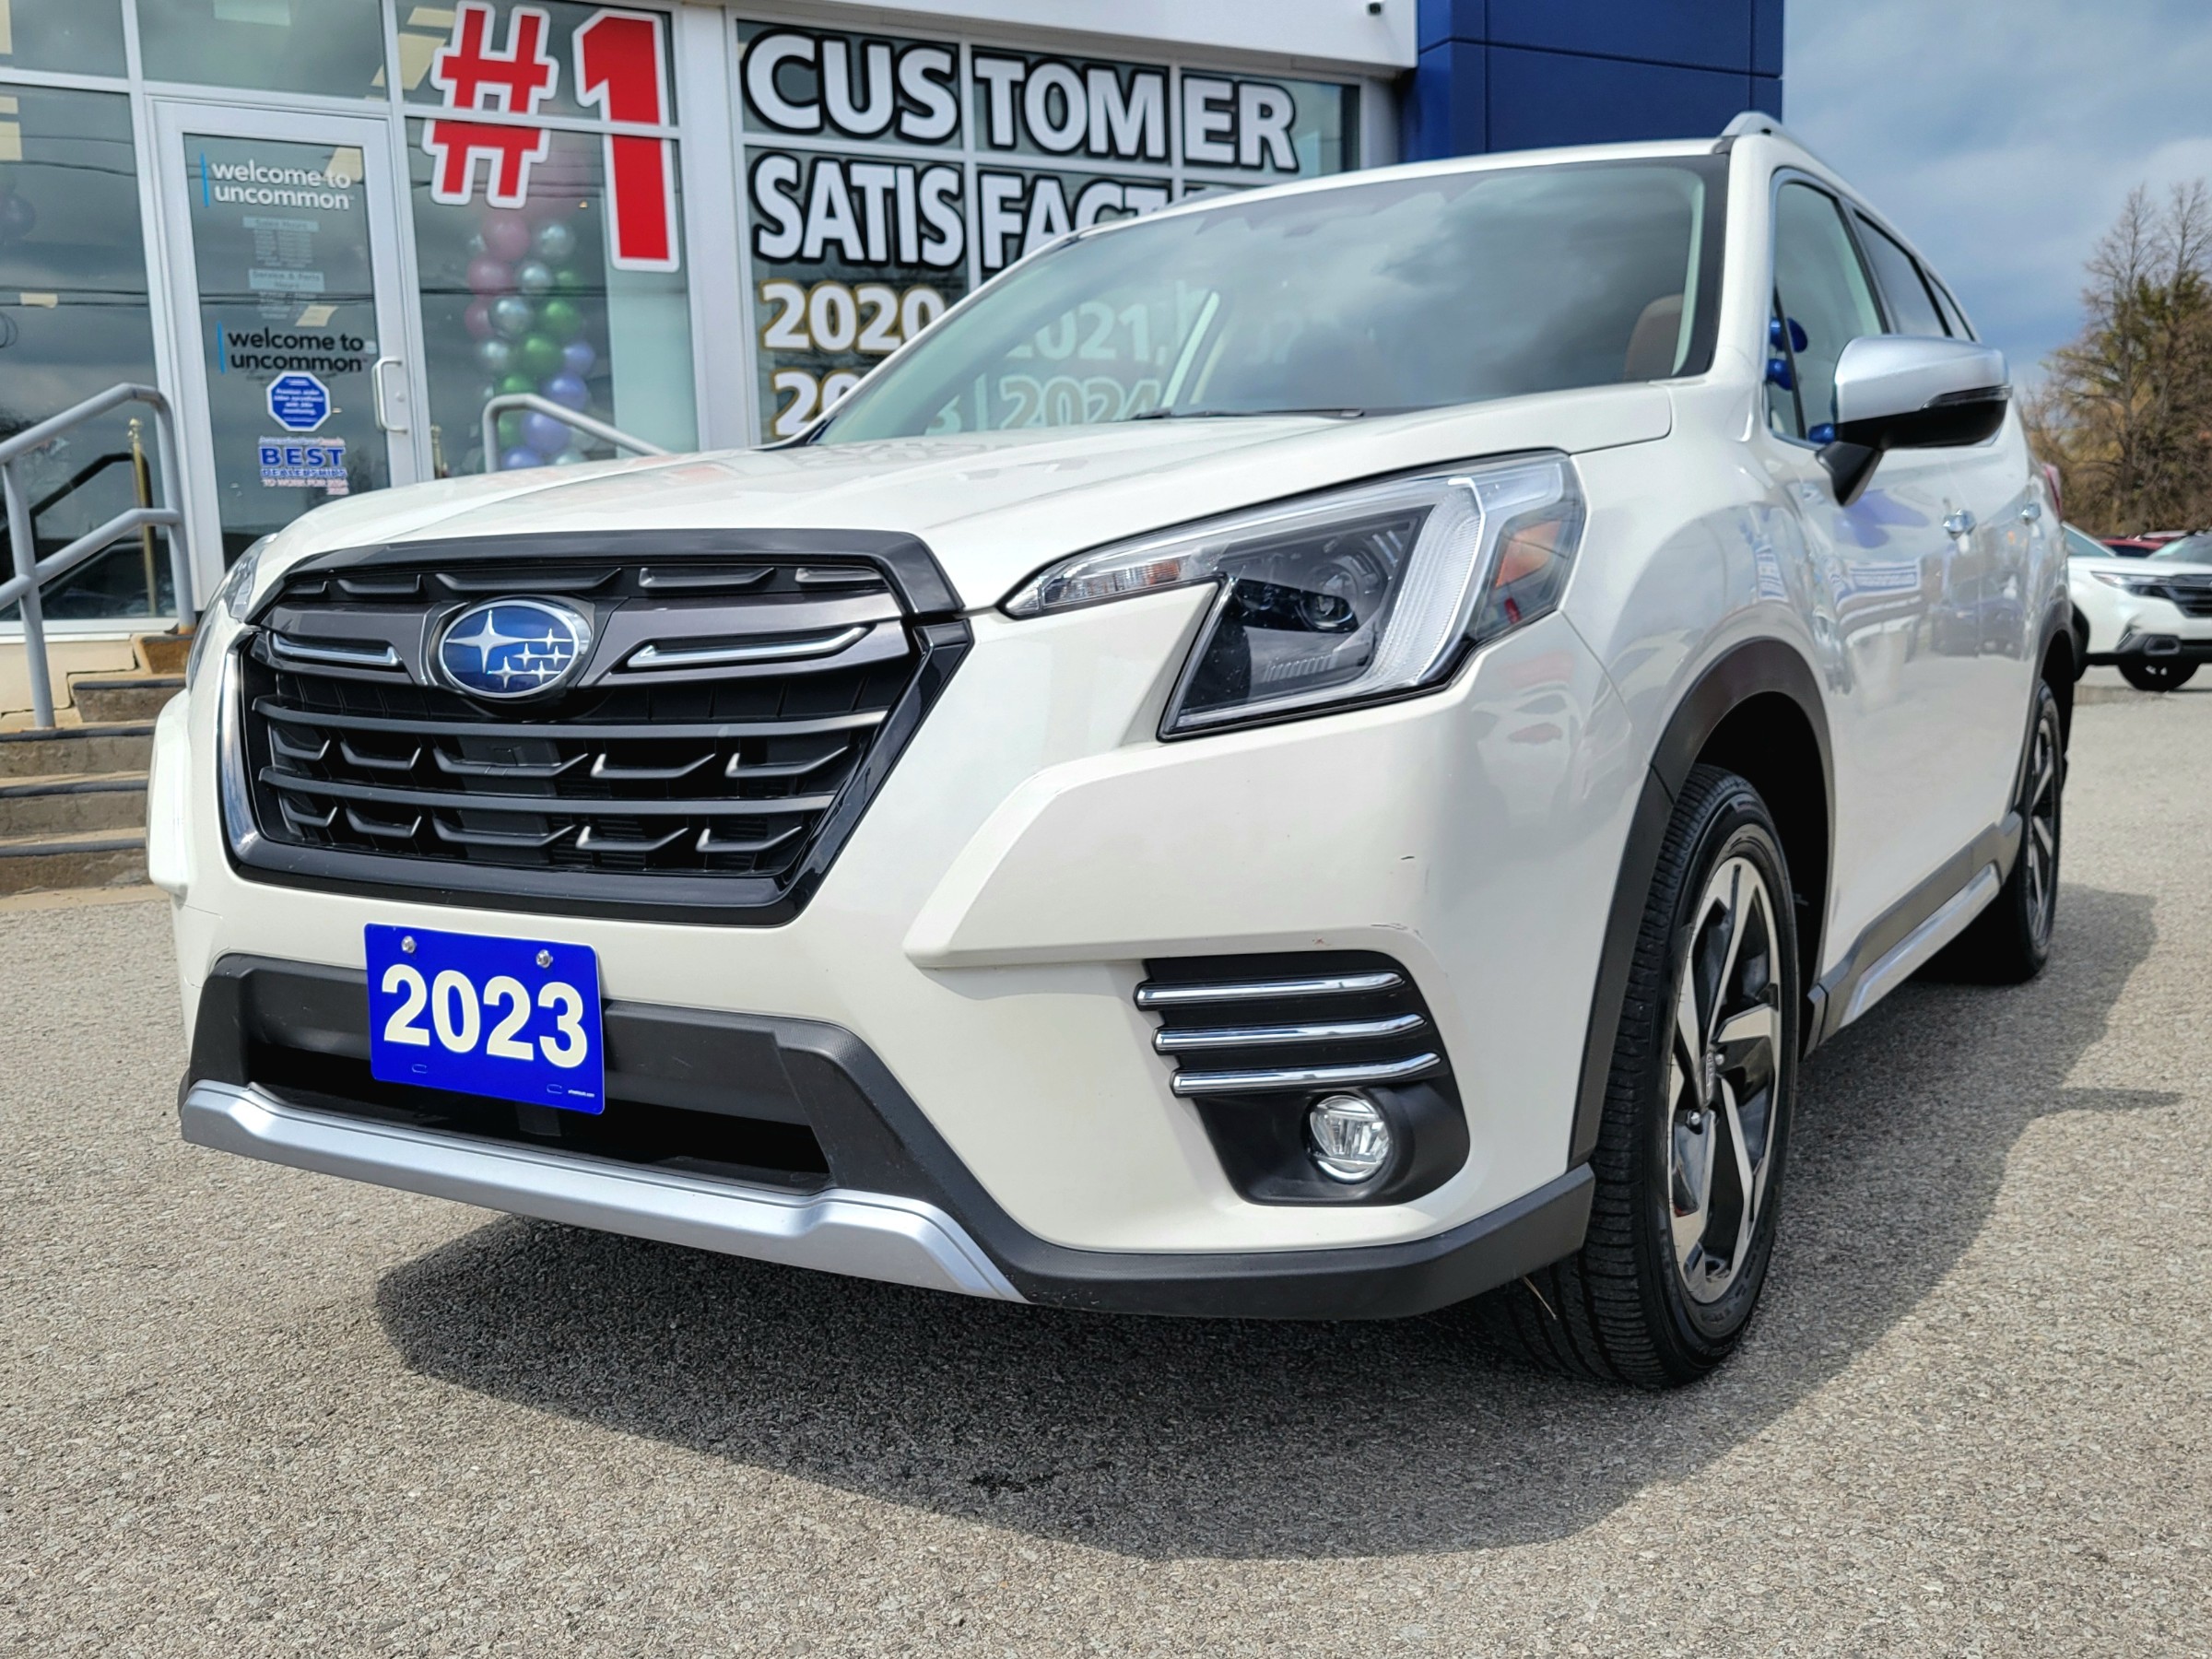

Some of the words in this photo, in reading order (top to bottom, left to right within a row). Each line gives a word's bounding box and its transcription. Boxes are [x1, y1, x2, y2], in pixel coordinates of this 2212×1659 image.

[745, 34, 1298, 171] CUSTOMER
[424, 3, 678, 270] #1
[211, 159, 322, 187] welcome
[326, 168, 351, 189] to
[214, 184, 349, 210] uncommon
[227, 325, 335, 350] welcome
[339, 333, 364, 352] to
[229, 353, 363, 372] uncommon
[260, 447, 346, 466] BEST
[381, 963, 588, 1069] 2023
